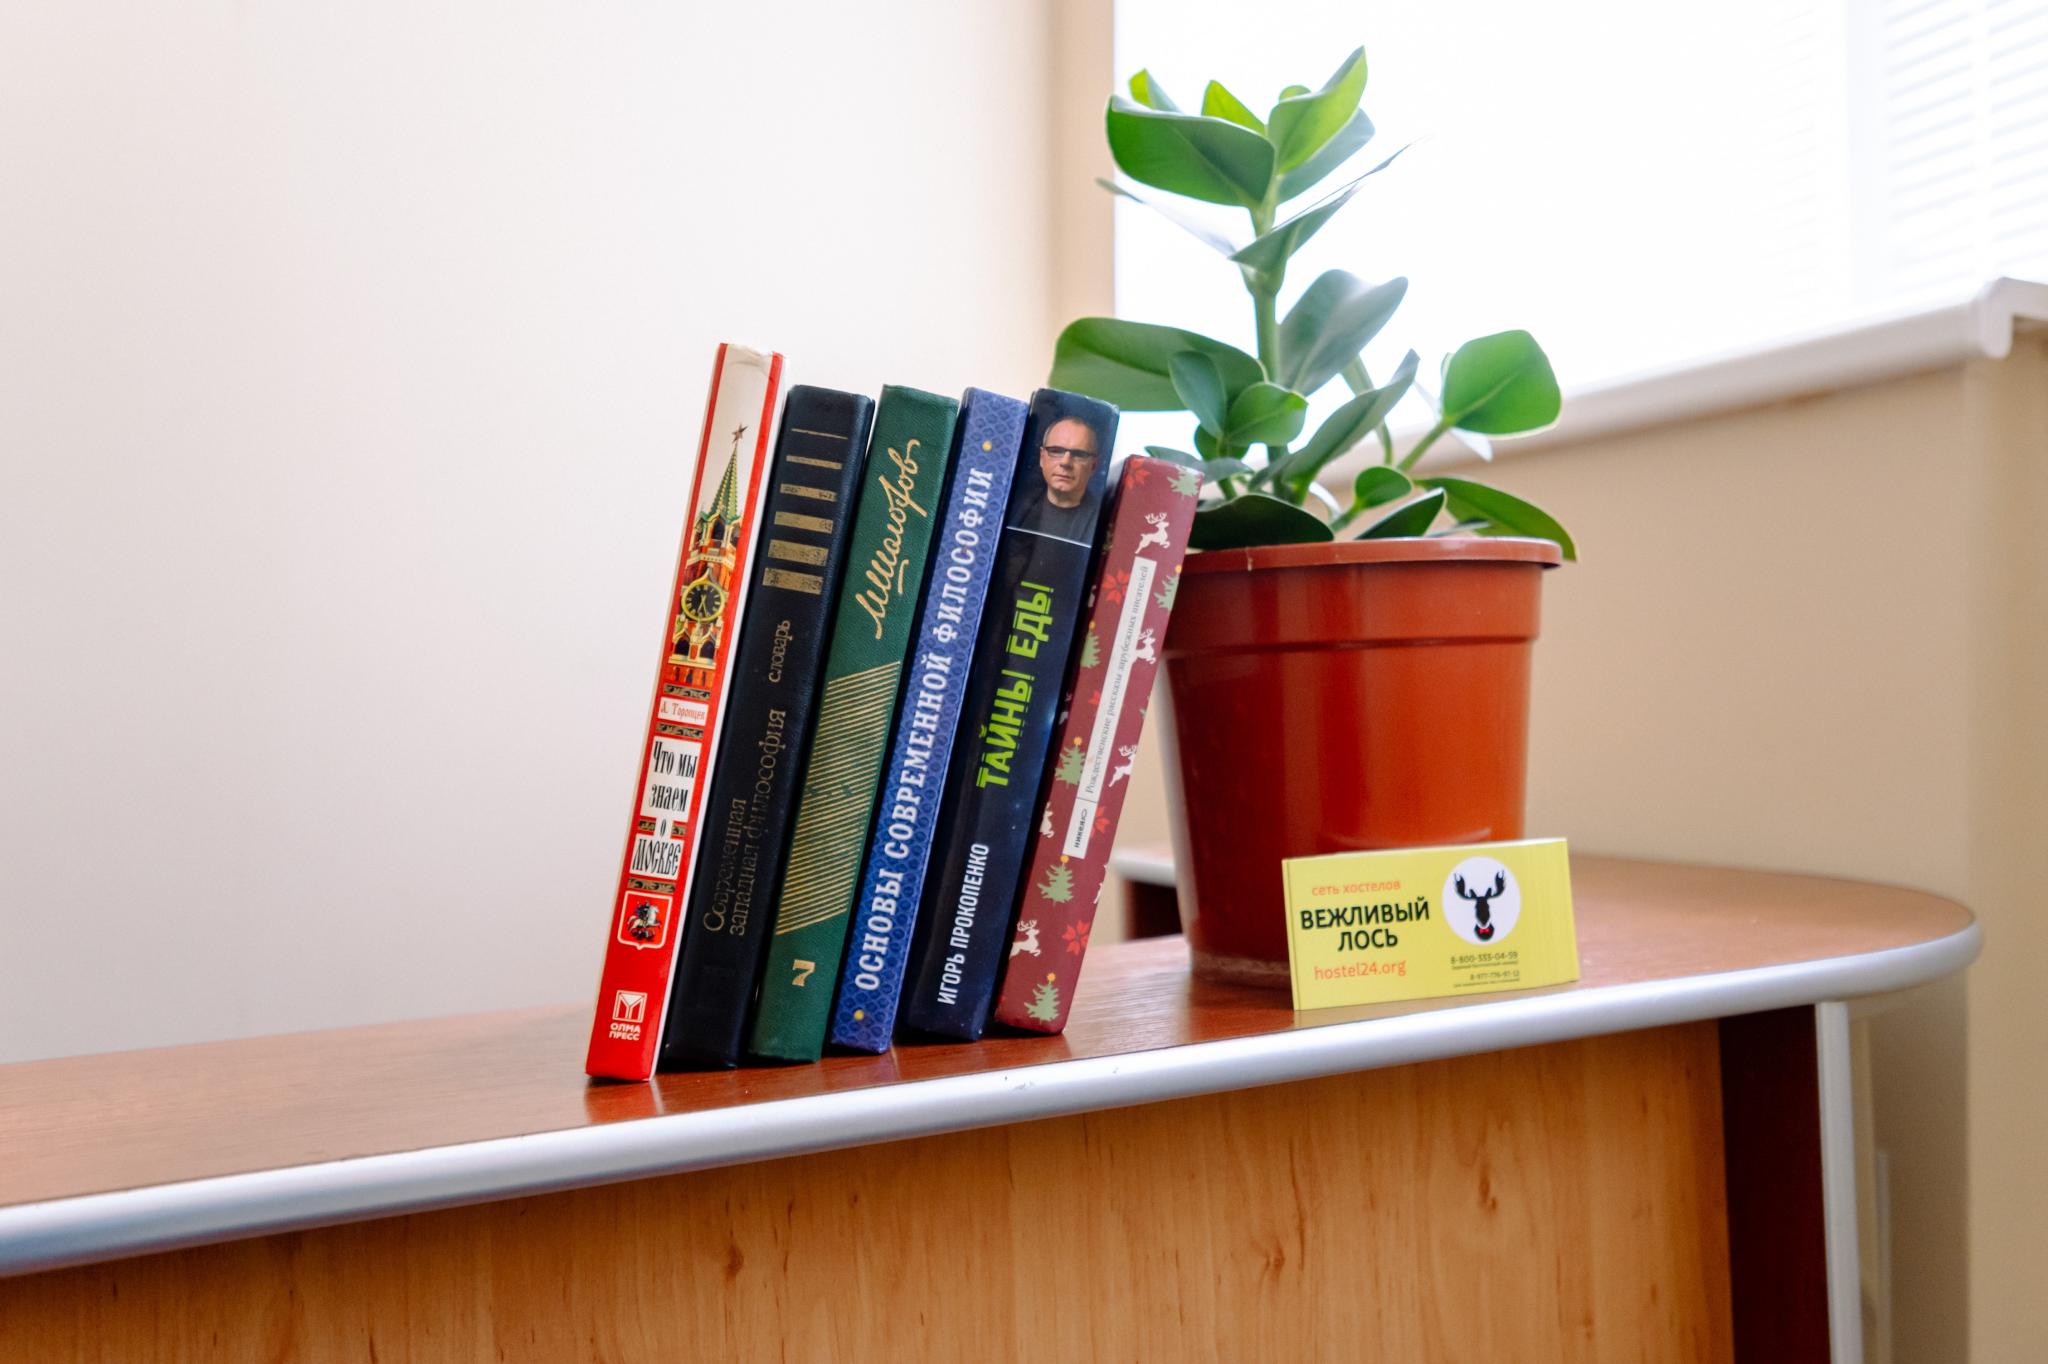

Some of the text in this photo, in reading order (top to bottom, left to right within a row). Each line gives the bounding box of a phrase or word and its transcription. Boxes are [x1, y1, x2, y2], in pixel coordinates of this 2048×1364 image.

[768, 619, 793, 683] словарь
[976, 580, 1055, 789] ТАЙНЫ ЕДЫ
[1086, 566, 1148, 794] Рождественские рассказы зарубежных писателей
[855, 468, 993, 991] ОСНОВЫ СОВРЕМЕННОЙ ФИЛОСОФИИ
[653, 741, 698, 778] Что мы
[649, 783, 689, 812] знаем
[660, 818, 667, 834] о
[730, 709, 787, 936] западная философия
[703, 798, 746, 931] Современная
[1312, 879, 1401, 896] сеть хостелов
[937, 843, 990, 1005] ИГОРЬ ПРОКОПЕНКО
[1300, 896, 1430, 930] ВЕЖЛИВЫЙ
[1337, 928, 1399, 951] ЛОСЬ
[792, 959, 816, 987] 7
[1314, 960, 1406, 981] hostel24.org
[609, 1030, 640, 1041] ПРЕСС
[610, 1022, 641, 1033] ОЛМА
